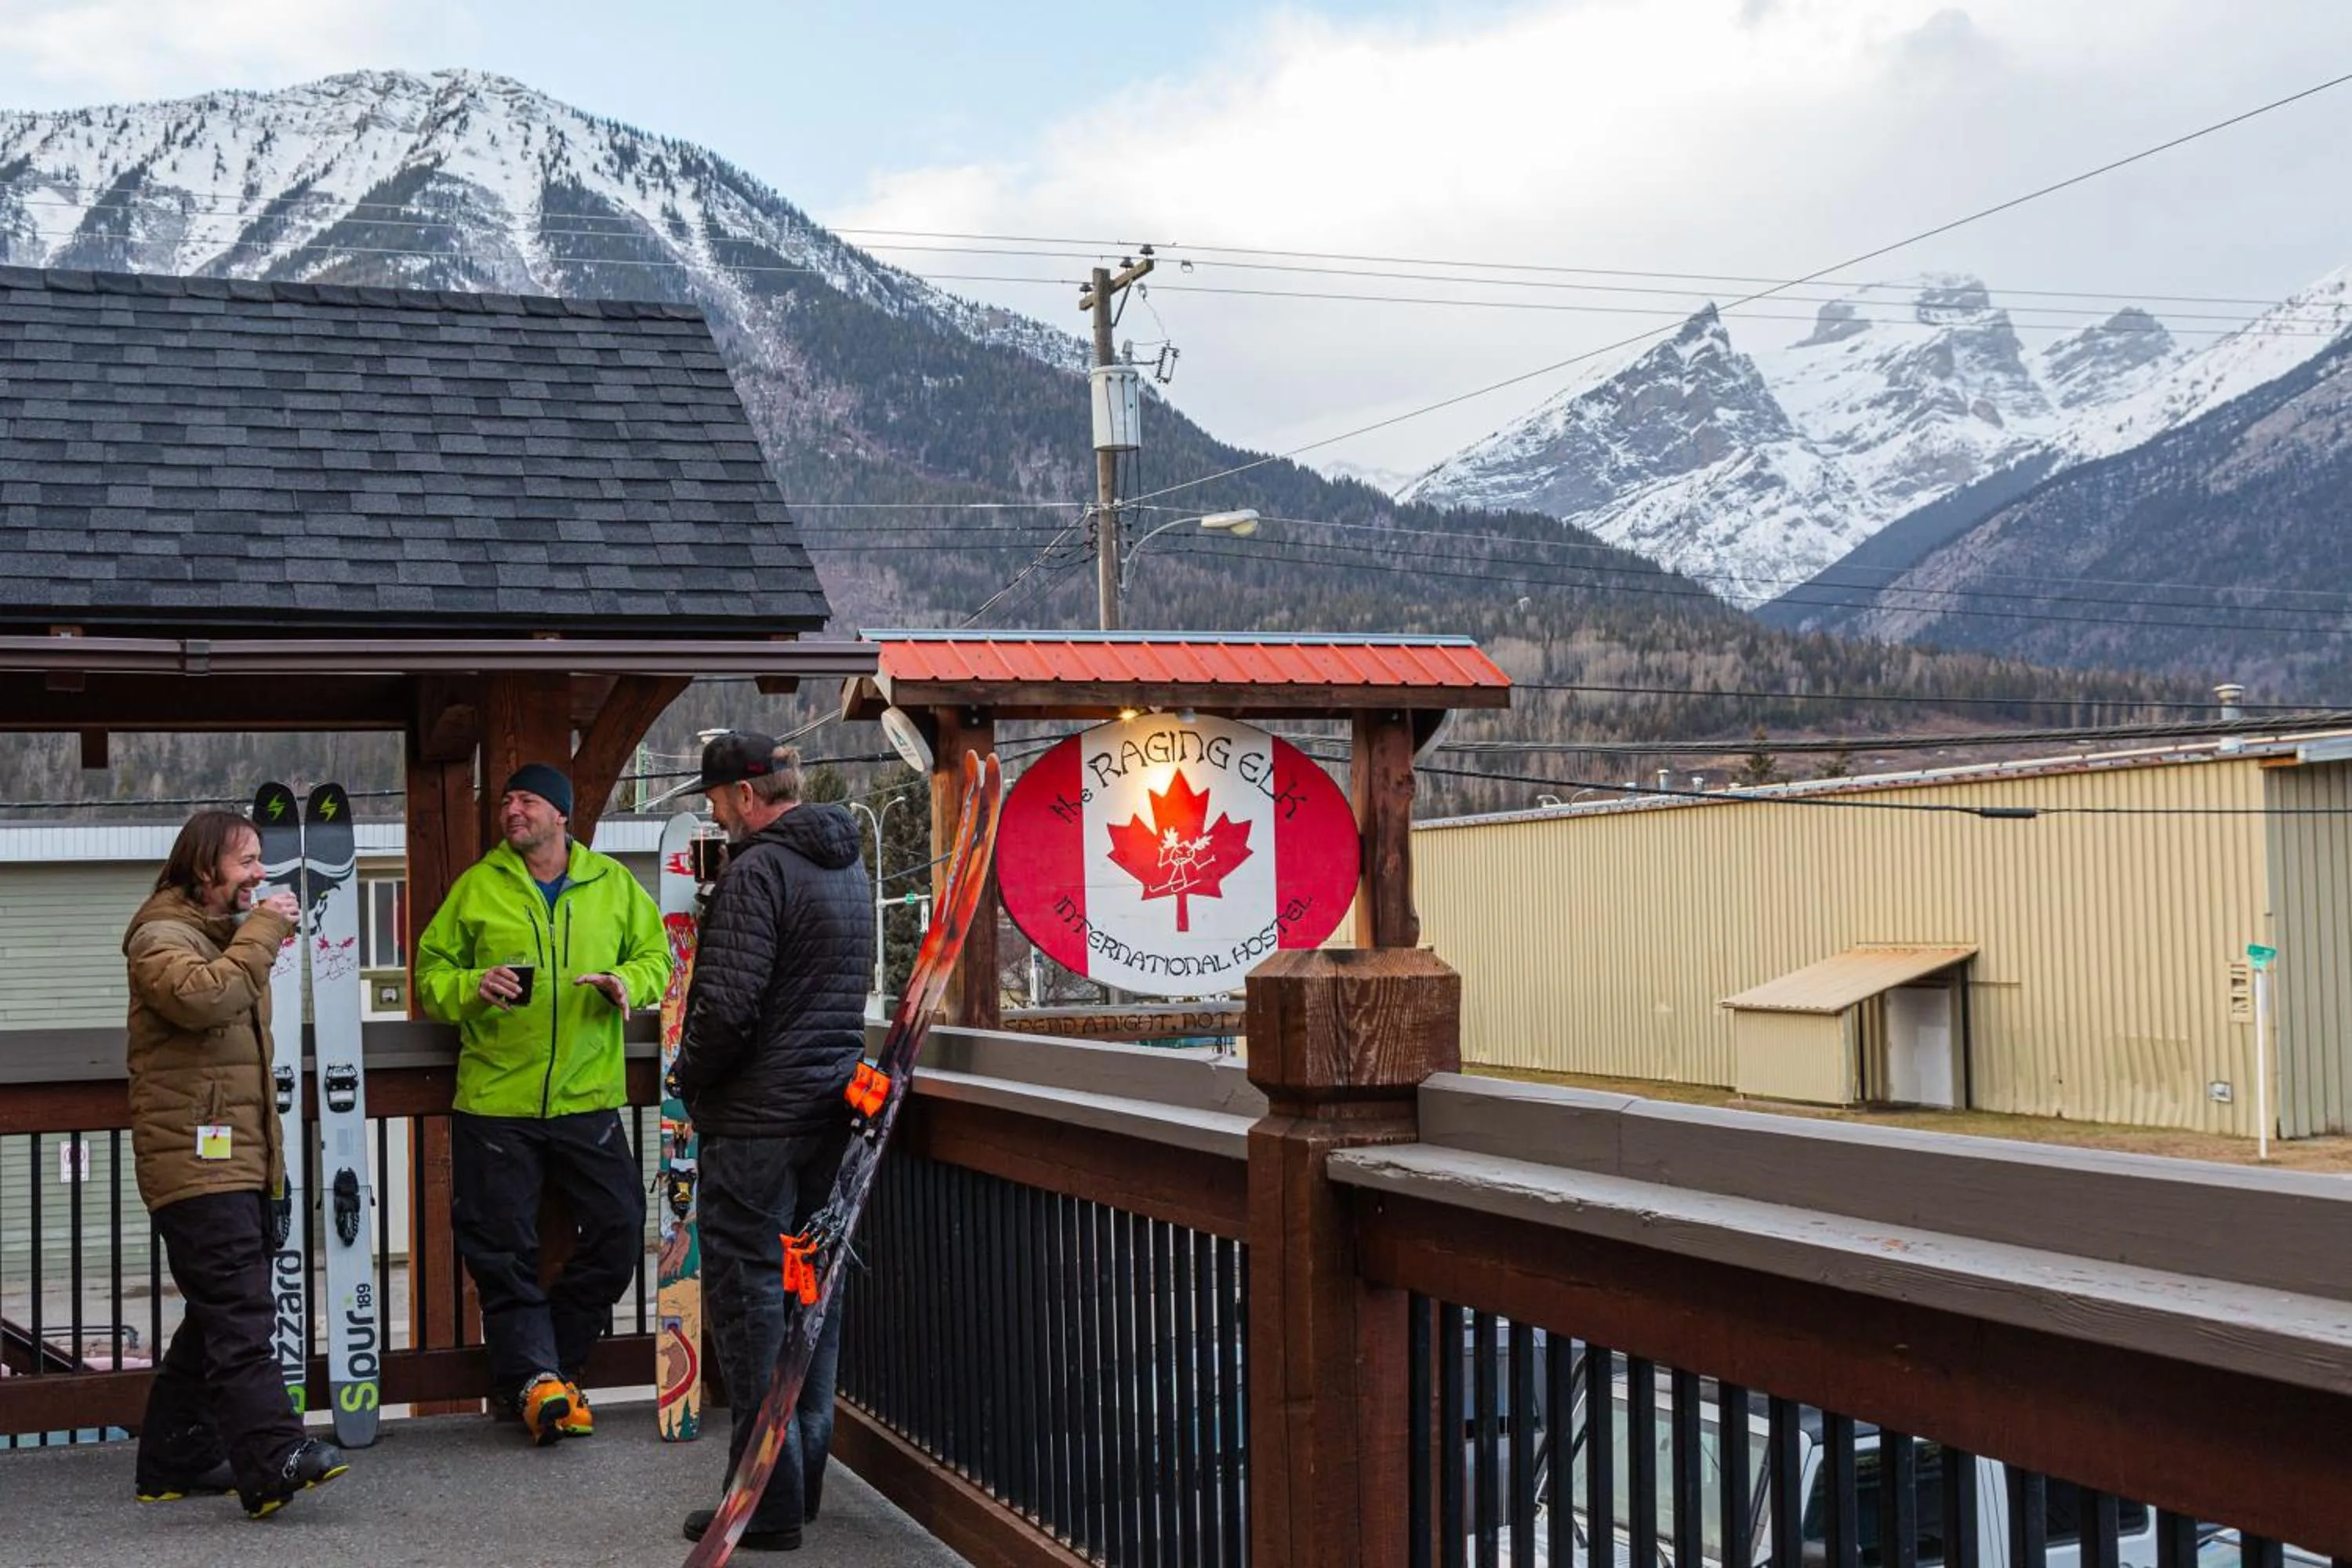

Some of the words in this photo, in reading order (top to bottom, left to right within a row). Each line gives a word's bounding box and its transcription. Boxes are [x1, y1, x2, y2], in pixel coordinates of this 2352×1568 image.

[1087, 730, 1232, 788] RAGING
[1239, 752, 1308, 818] ELK
[1054, 894, 1231, 976] INTERNATIONAL
[1232, 896, 1312, 965] HOSTEL
[1181, 1011, 1232, 1029] NOT
[356, 1283, 372, 1310] 189
[339, 1310, 379, 1412] Spur
